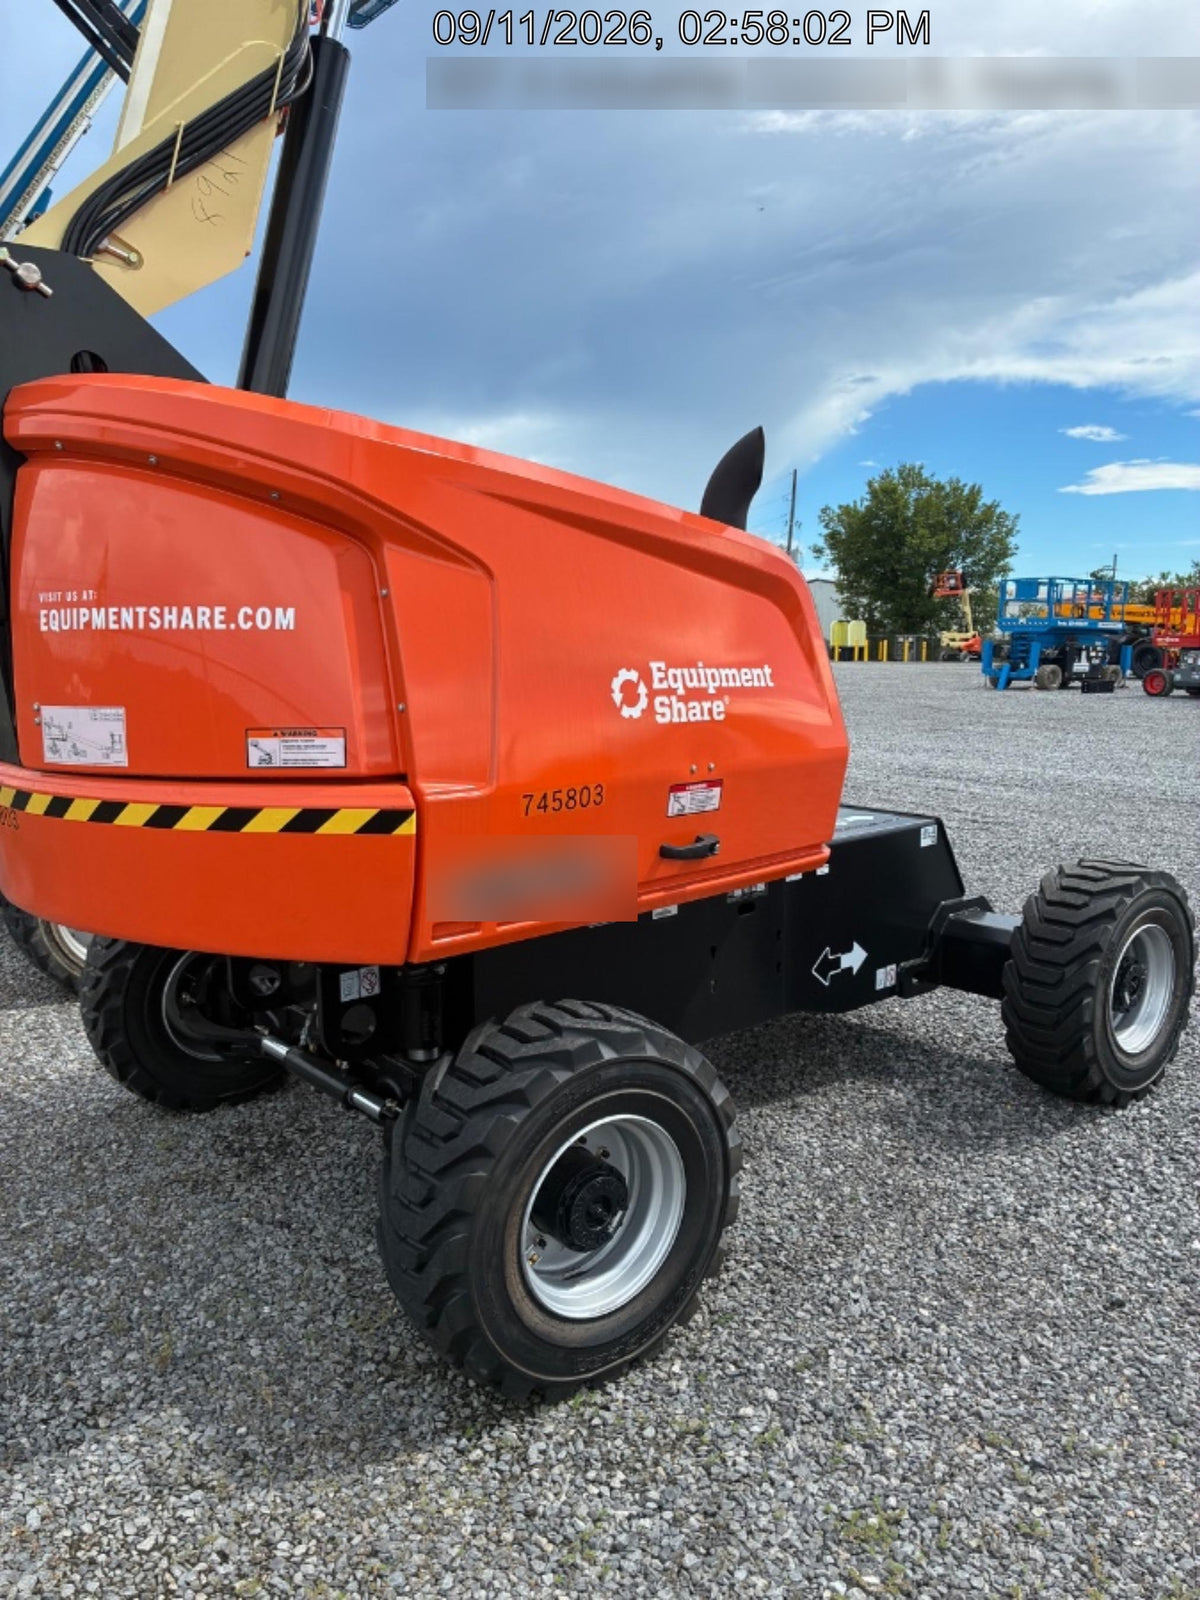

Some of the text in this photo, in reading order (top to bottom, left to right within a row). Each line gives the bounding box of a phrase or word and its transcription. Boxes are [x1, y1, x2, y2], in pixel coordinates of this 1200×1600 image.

[39, 591, 62, 603] VISIT
[66, 591, 78, 602] US
[39, 606, 296, 632] EQUIPMENTSHARE.COM
[649, 660, 775, 695] Equipment
[521, 783, 604, 817] 745803
